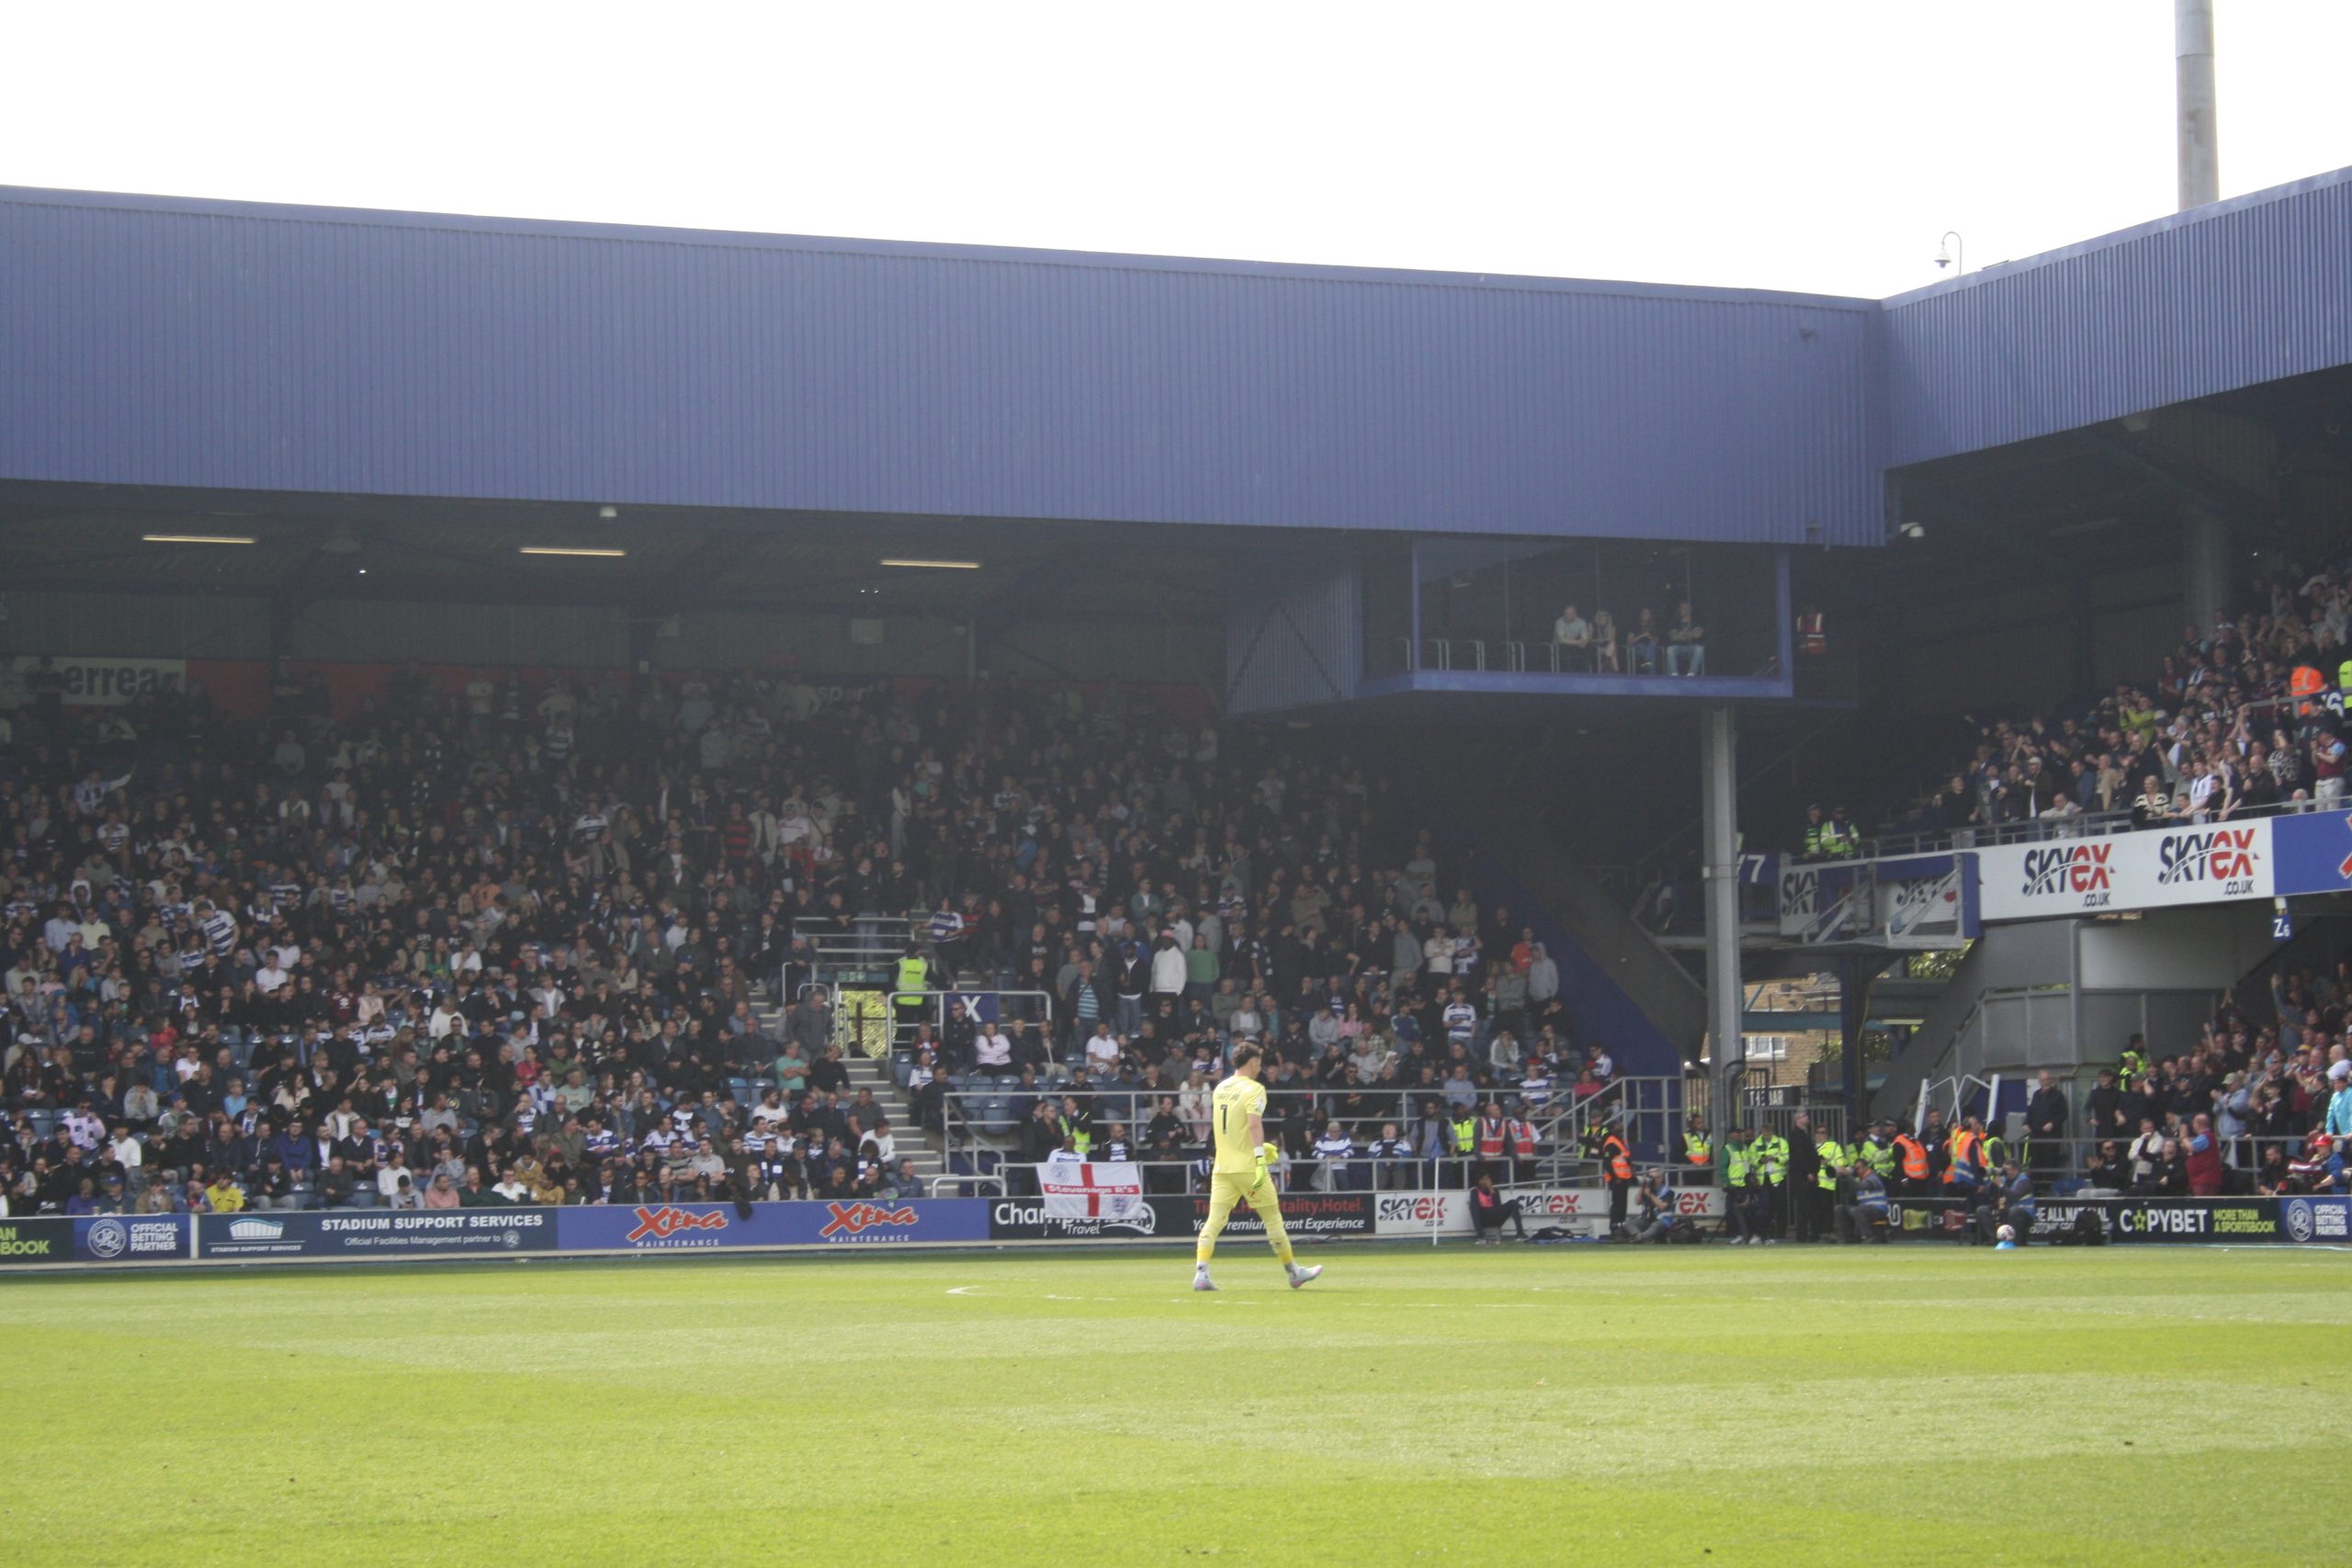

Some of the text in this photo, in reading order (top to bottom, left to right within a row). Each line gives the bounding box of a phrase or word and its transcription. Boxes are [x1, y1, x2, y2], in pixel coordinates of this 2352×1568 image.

[1736, 854, 1766, 883] 7
[2273, 918, 2290, 938] Z6
[961, 995, 982, 1022] X
[1220, 1104, 1227, 1134] 1
[2213, 1209, 2258, 1221] MORE THAN
[2315, 1204, 2347, 1214] OFFICIAL
[322, 1214, 543, 1231] STADIUM SUPPORT SERVICES
[627, 1205, 729, 1242] Xtra
[820, 1201, 919, 1237] Xtra
[1305, 1217, 1365, 1233] Experience
[2315, 1214, 2346, 1224] BETTING
[130, 1223, 179, 1233] OFFICIAL
[1067, 1224, 1102, 1235] Travel
[2222, 1222, 2276, 1234] SPORTSBOOK
[2315, 1224, 2348, 1235] PARTNER
[130, 1232, 175, 1242] BETTING
[410, 1235, 462, 1247] Management
[463, 1235, 492, 1245] partner
[492, 1235, 502, 1243] to
[637, 1237, 719, 1247] MAINTENANCE
[830, 1234, 910, 1244] MAINTENANCE
[130, 1241, 176, 1251] PARTNER
